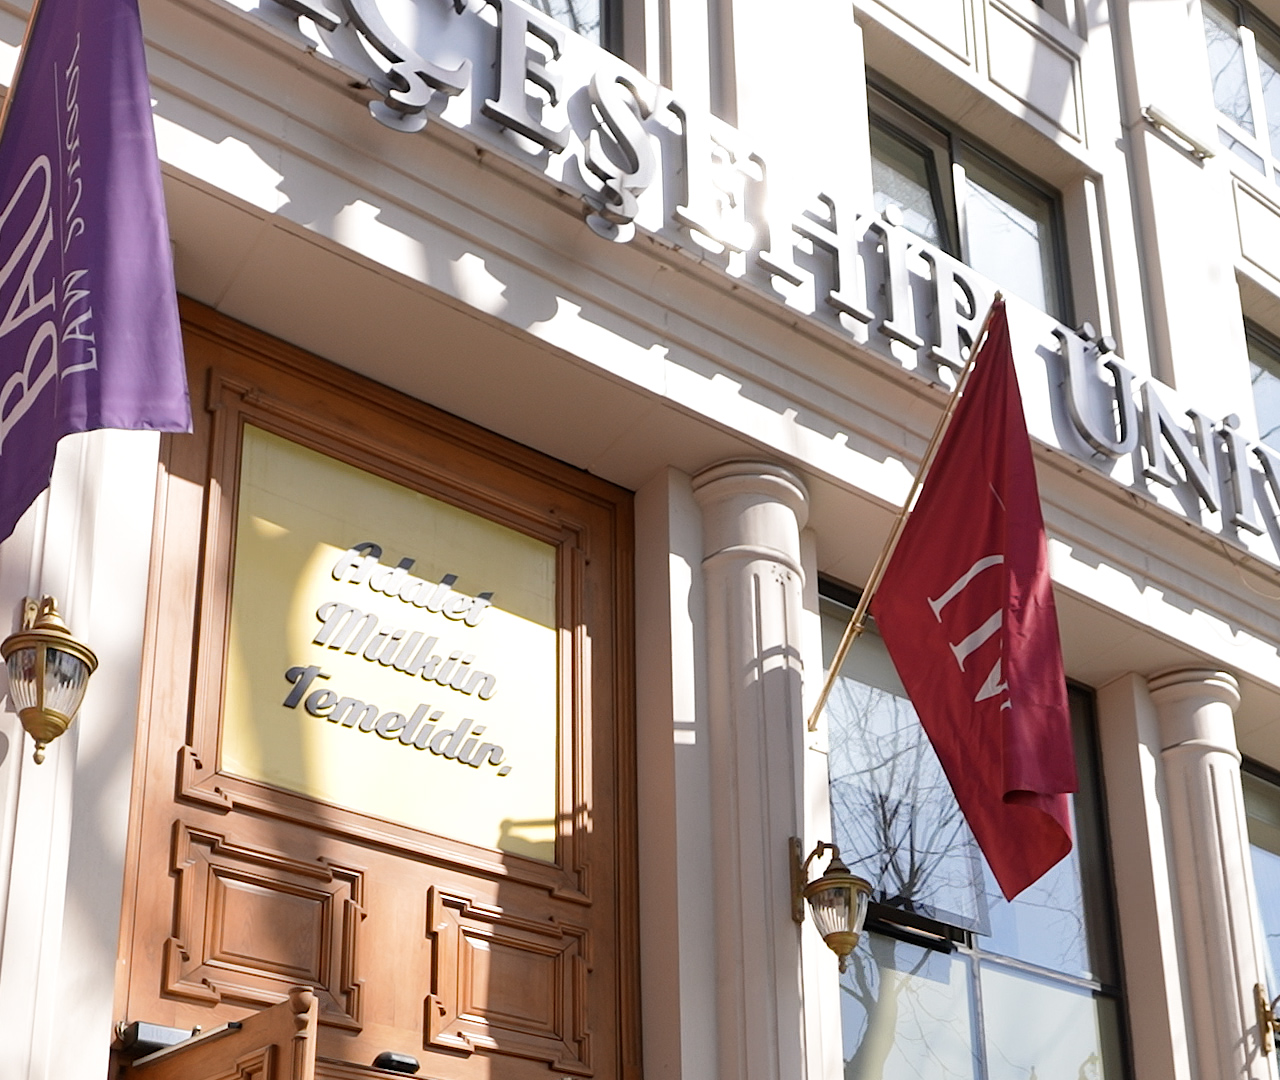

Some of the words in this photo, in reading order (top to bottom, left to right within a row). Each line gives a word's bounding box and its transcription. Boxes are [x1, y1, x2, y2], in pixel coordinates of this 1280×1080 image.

[61, 268, 99, 383] LAW
[331, 541, 495, 628] Adalet
[311, 601, 498, 701] Mülkün
